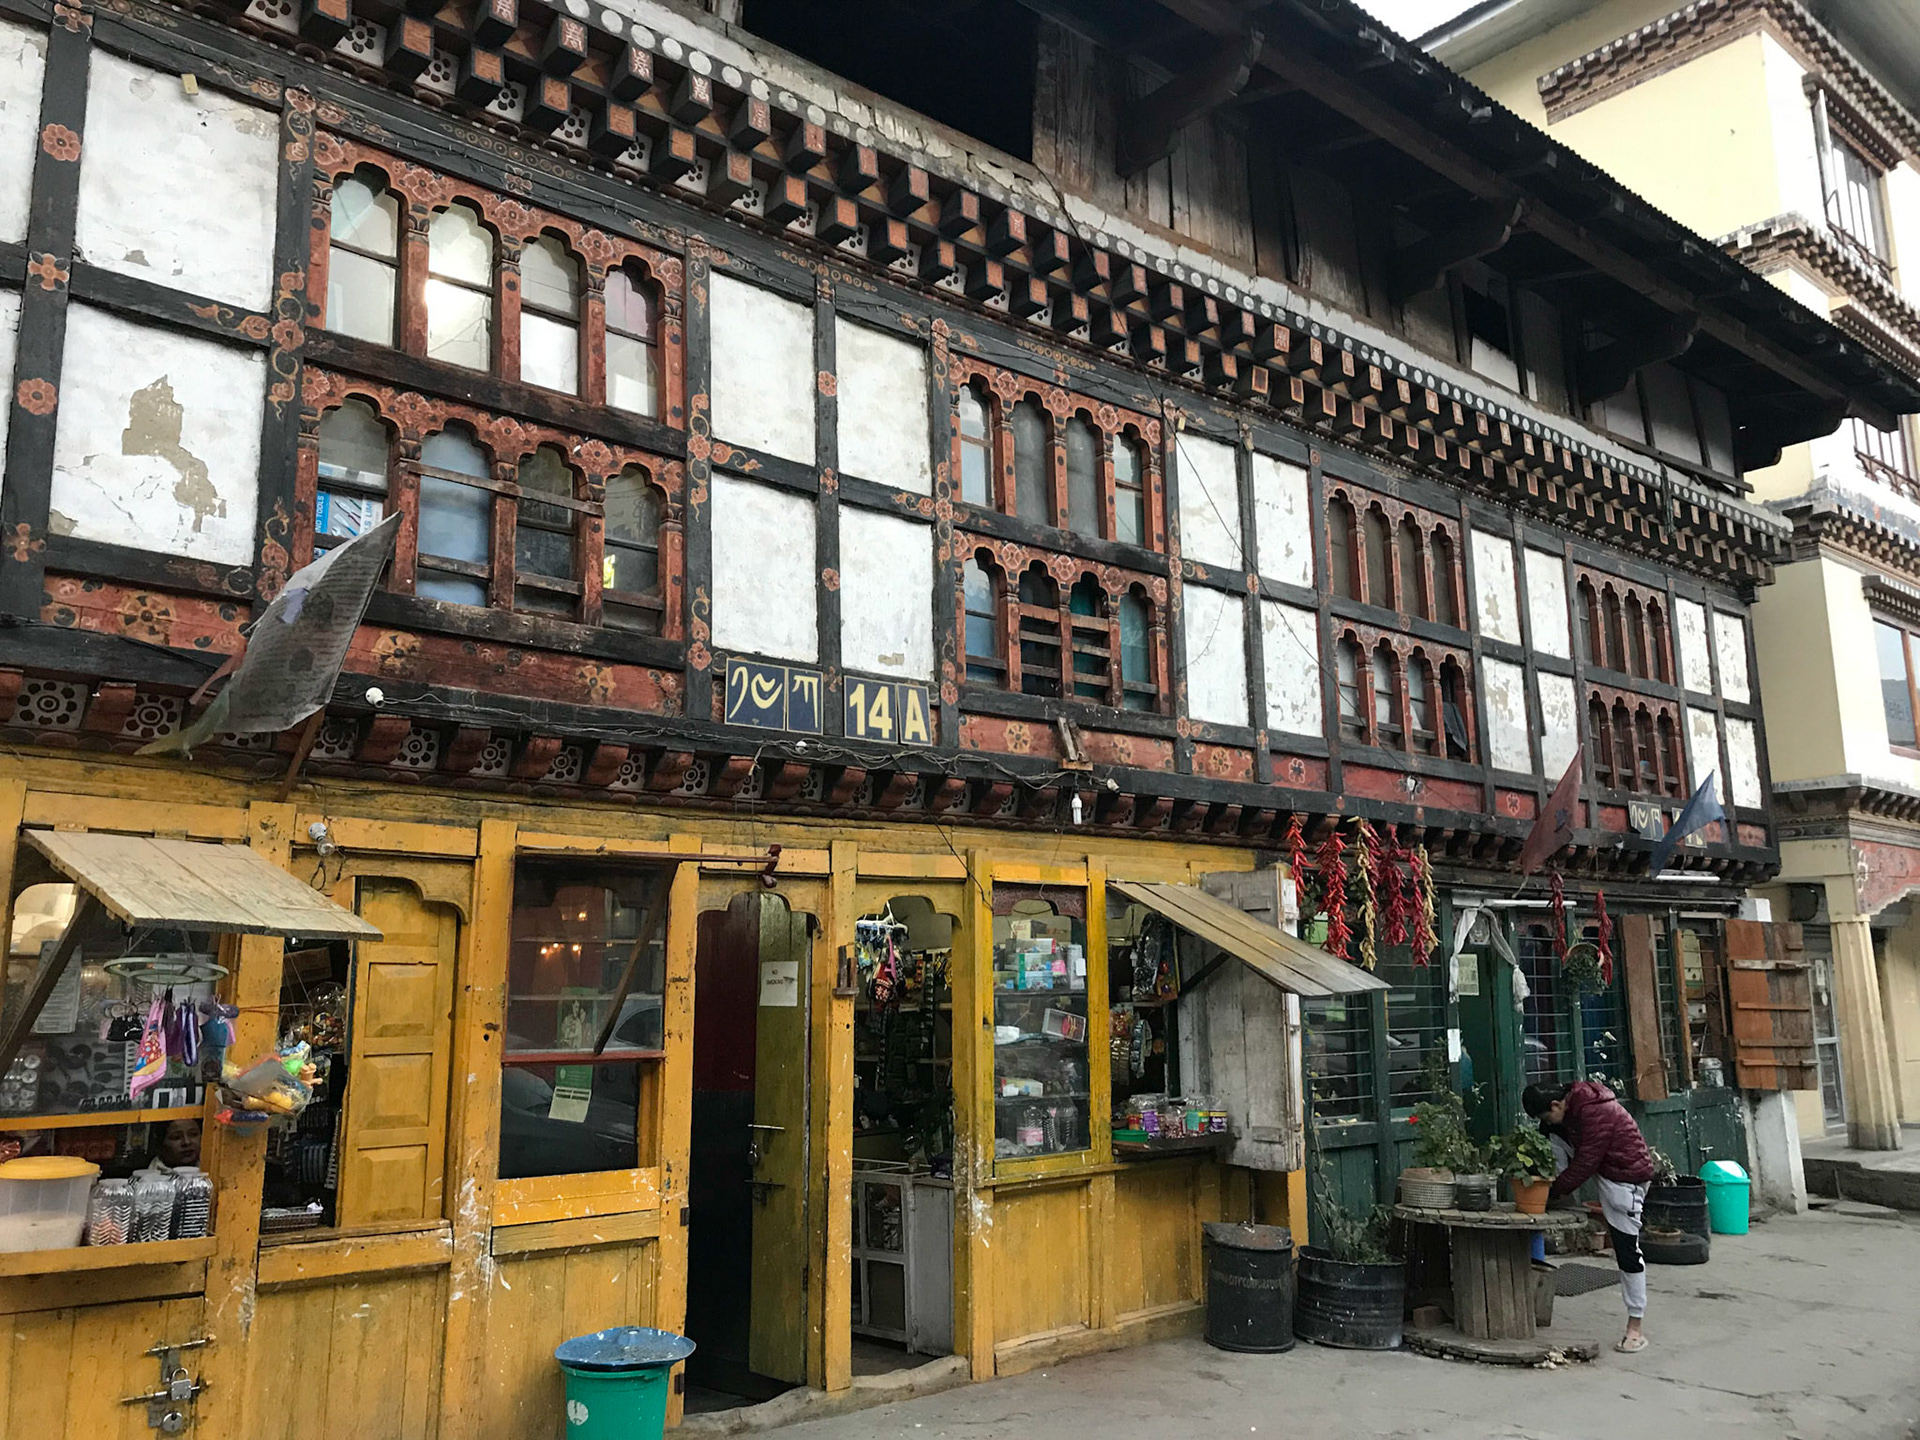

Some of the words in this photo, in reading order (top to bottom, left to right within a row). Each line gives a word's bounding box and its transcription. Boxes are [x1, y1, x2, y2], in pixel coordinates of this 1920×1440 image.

[316, 495, 324, 518] TOOLS
[728, 666, 783, 719] ༡༤
[792, 675, 819, 729] ཀ
